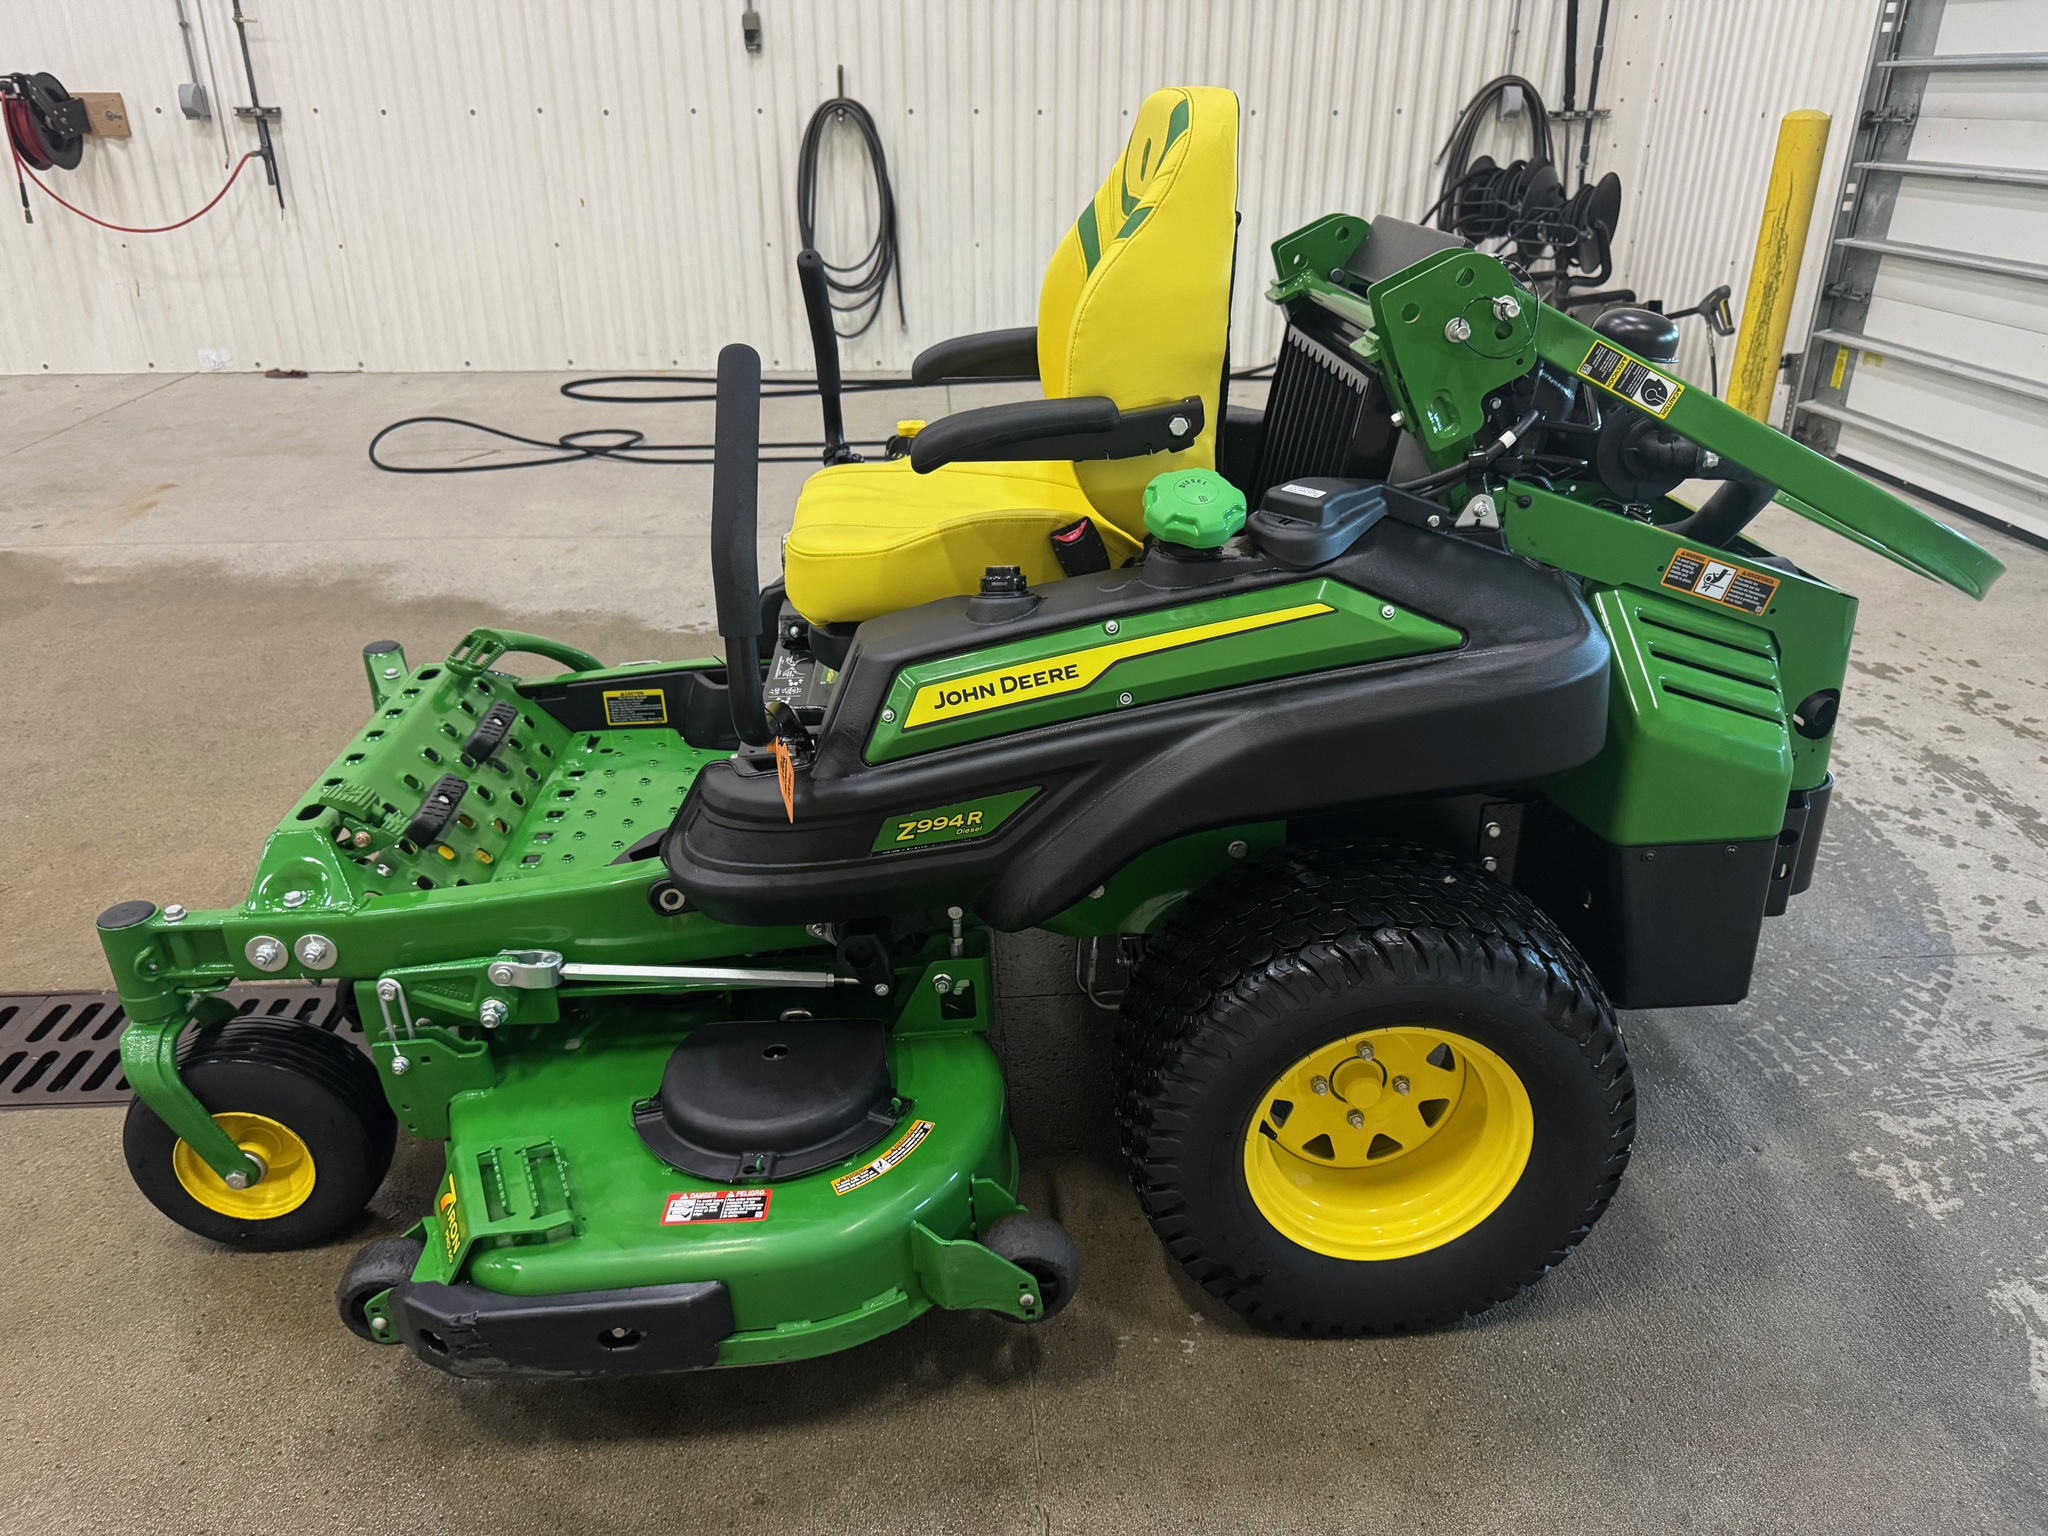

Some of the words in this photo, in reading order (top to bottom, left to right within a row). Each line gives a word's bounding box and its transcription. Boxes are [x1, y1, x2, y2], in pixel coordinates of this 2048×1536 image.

[1661, 390, 1680, 416] CAUTION
[1179, 479, 1207, 488] DIESEL
[934, 683, 996, 710] JOHN
[1000, 664, 1079, 694] DEERE
[956, 826, 983, 835] Diesel
